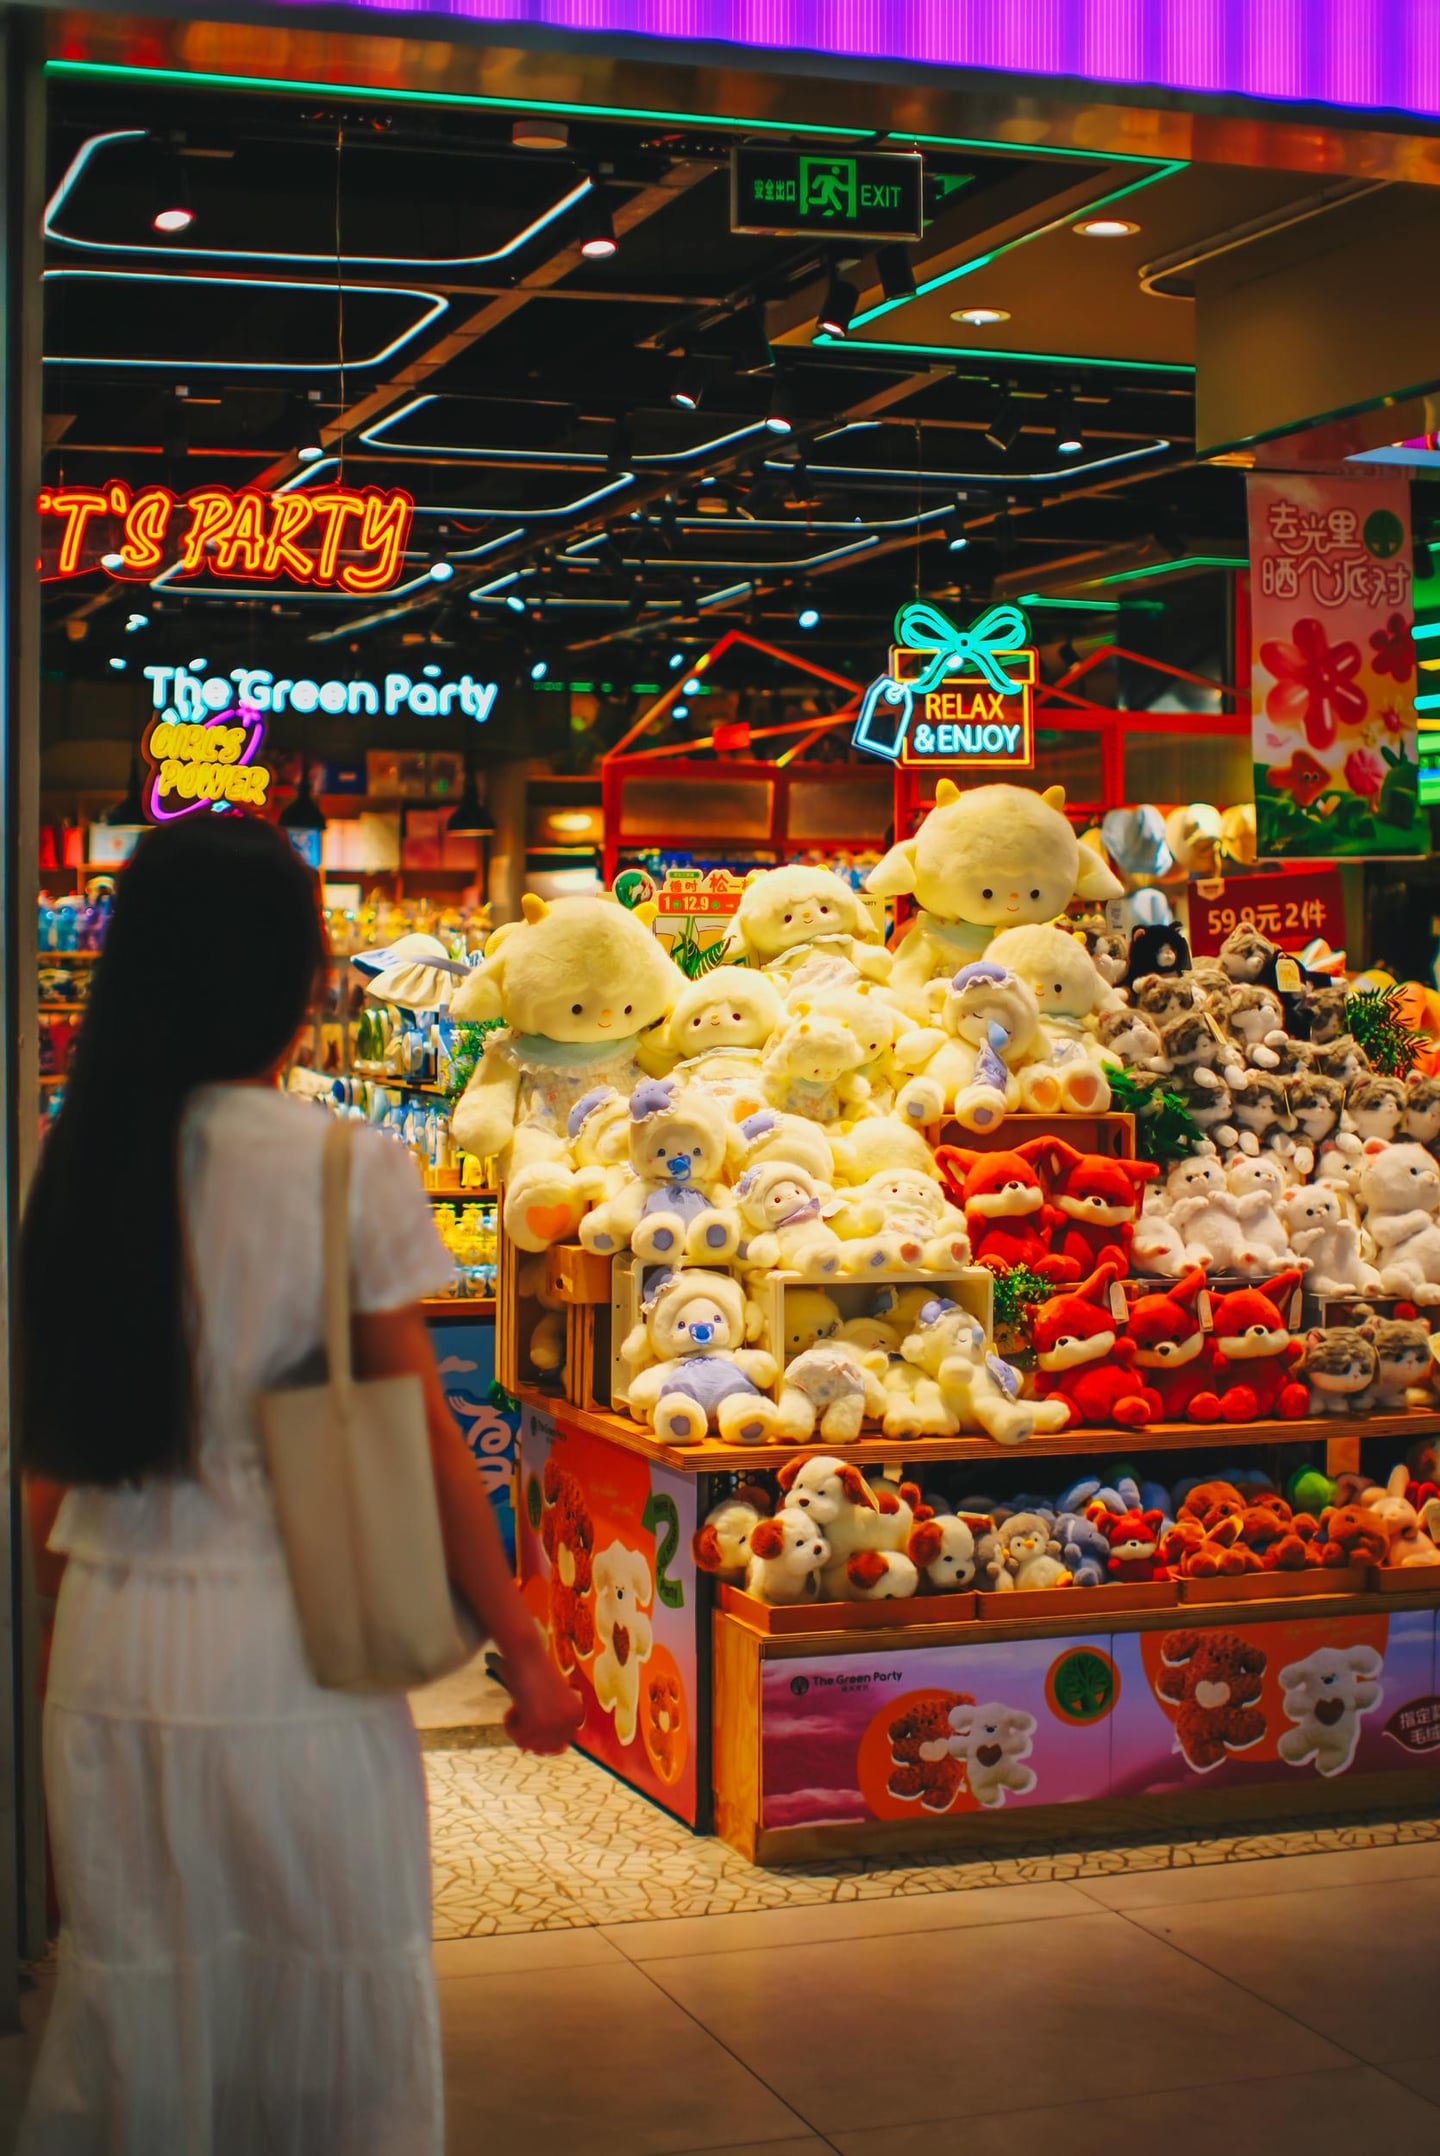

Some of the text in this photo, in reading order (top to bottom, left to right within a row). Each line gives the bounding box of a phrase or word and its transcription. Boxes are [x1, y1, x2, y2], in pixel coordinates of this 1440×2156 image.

[754, 179, 901, 208] 安全出口 EXIT
[39, 486, 408, 591] T'S PARTY
[1269, 501, 1361, 555] 去光里
[1262, 554, 1408, 607] 晒个派对
[144, 666, 498, 722] The Green Party
[925, 693, 1004, 720] RELAX
[157, 759, 270, 806] POWER
[682, 895, 709, 911] 12.9
[813, 1671, 902, 1687] The Green Party
